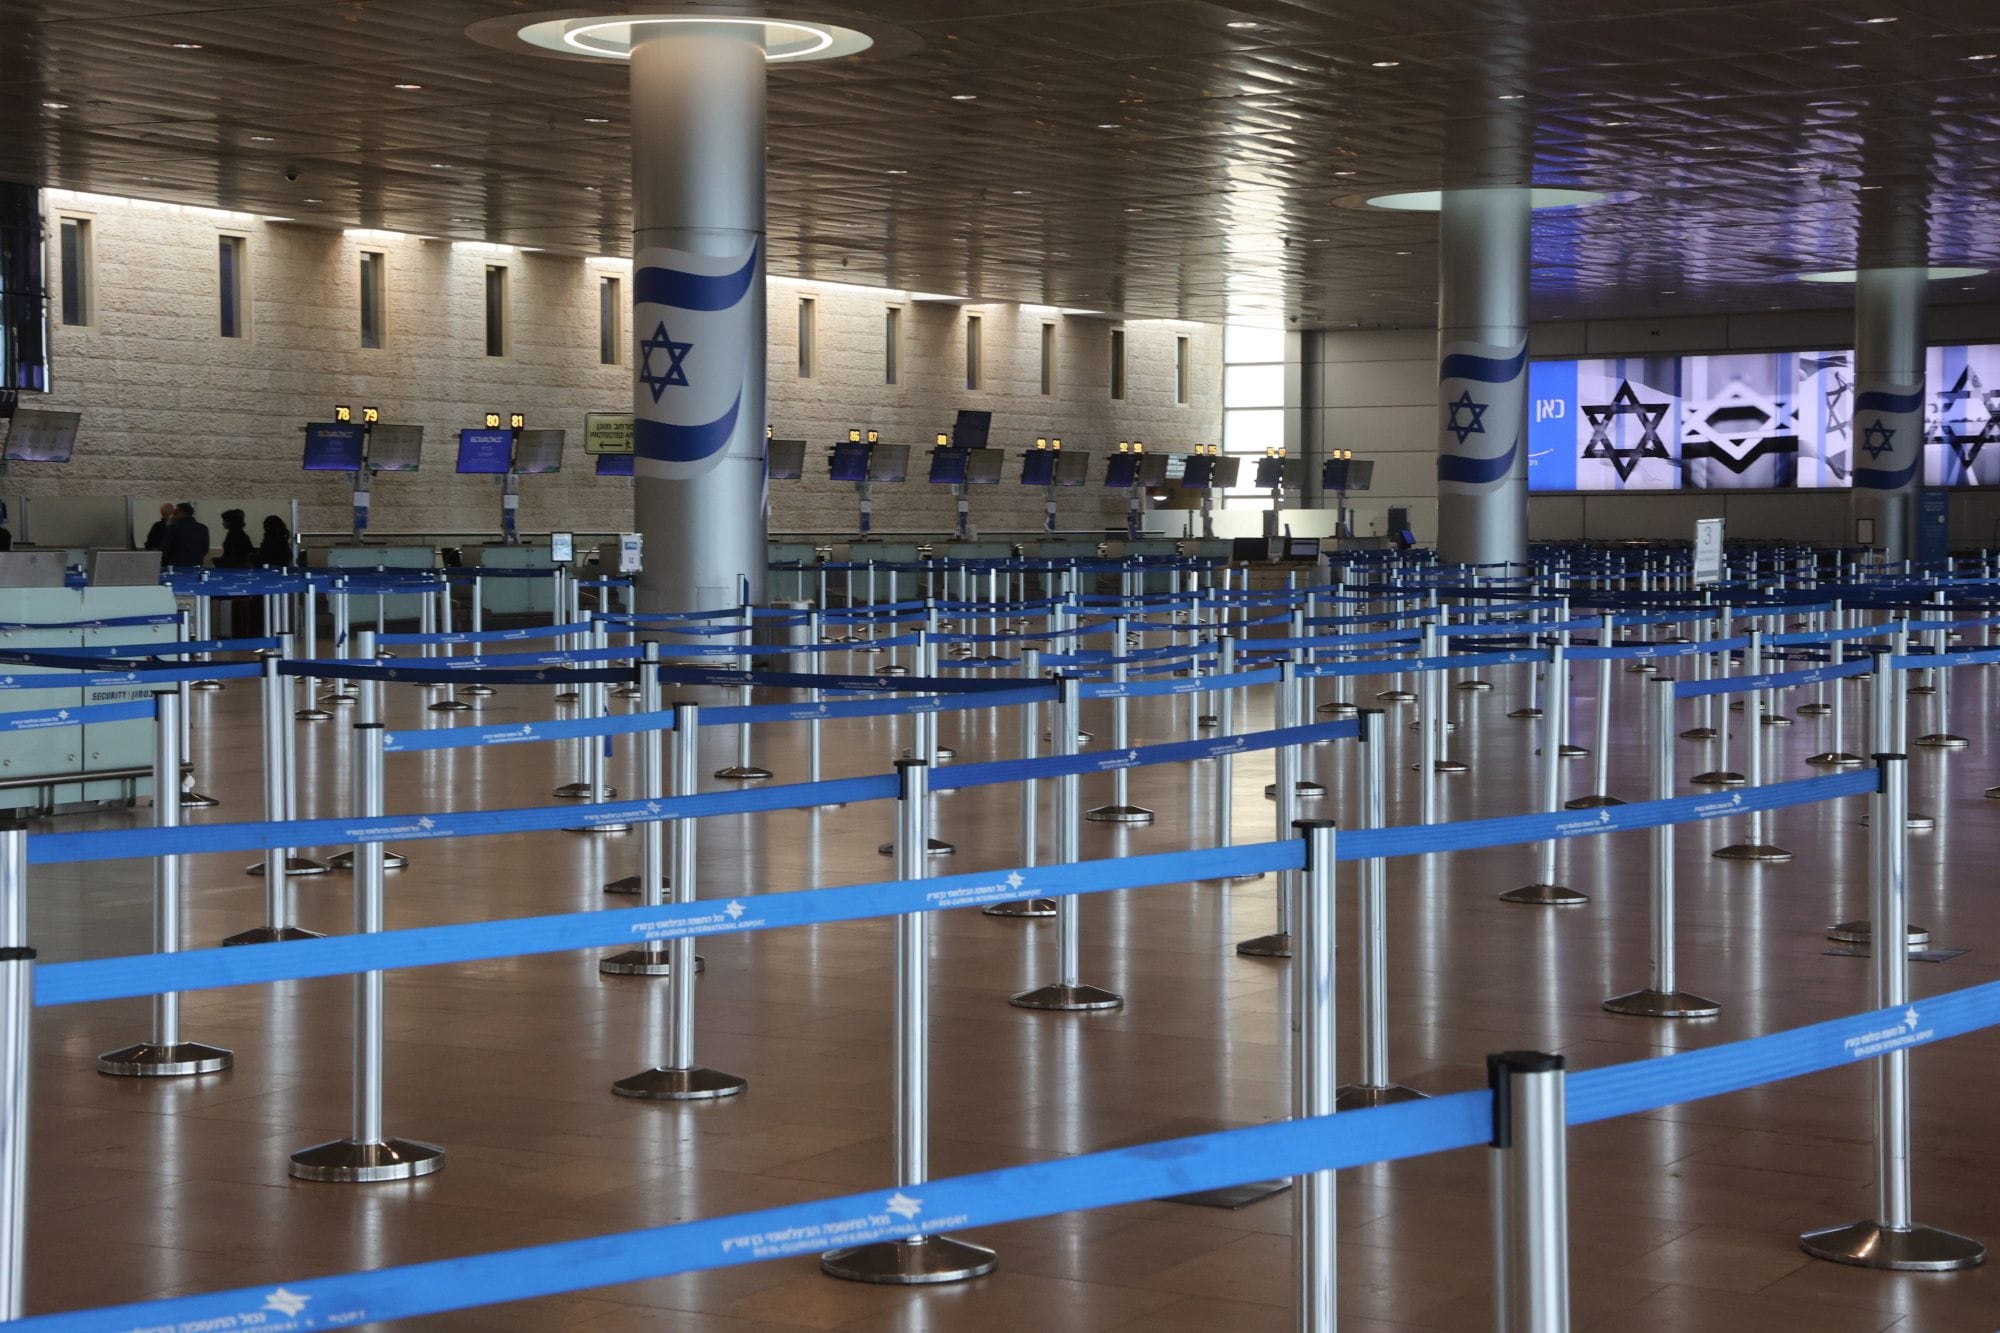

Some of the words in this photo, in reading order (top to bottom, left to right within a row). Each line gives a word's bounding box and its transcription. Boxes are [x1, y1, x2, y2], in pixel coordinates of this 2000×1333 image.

[335, 407, 350, 421] 78
[363, 408, 378, 422] 79
[1536, 399, 1565, 423] כאן
[486, 414, 499, 427] 80
[511, 414, 523, 428] 81
[868, 431, 878, 442] 87
[1704, 526, 1712, 546] 3
[92, 690, 127, 701] SECURITY
[921, 1214, 967, 1231] AIRPORT
